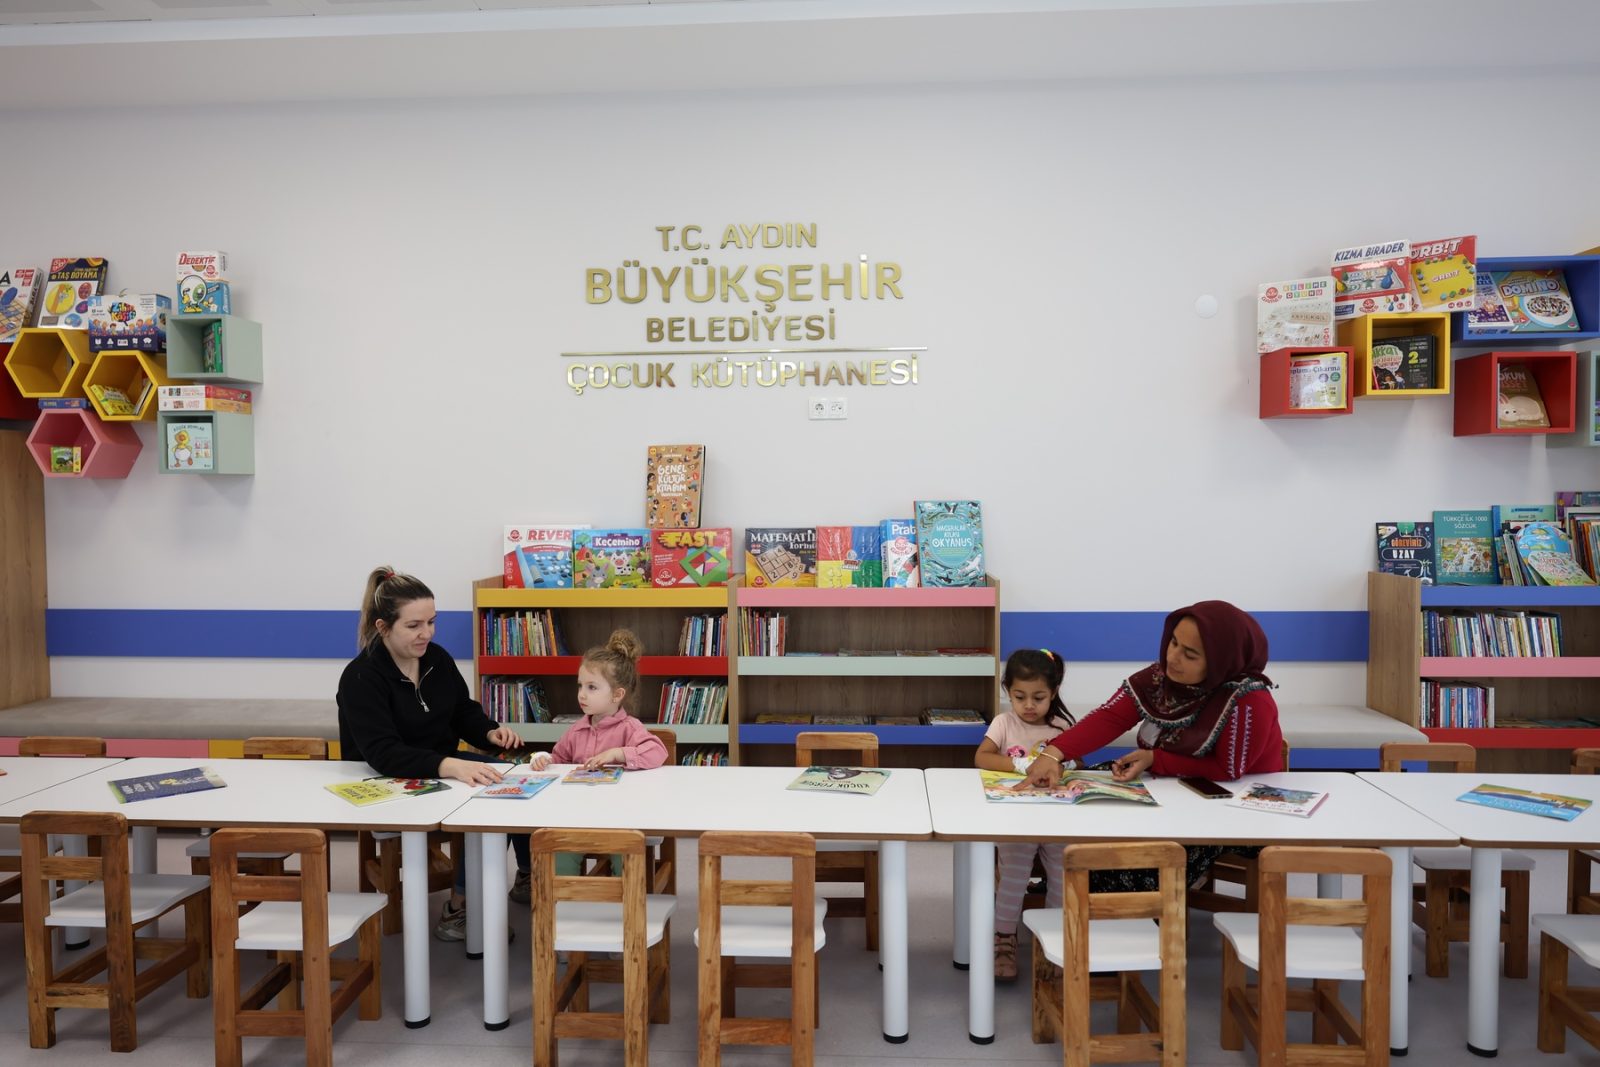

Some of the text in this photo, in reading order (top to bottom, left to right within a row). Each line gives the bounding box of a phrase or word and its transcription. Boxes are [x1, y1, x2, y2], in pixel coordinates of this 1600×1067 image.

[655, 222, 818, 252] T.C. AYDIN
[585, 253, 904, 313] BÜYÜKŞEHİR
[646, 308, 837, 343] BELEDİYESİ
[1408, 350, 1419, 364] 2
[566, 353, 919, 395] ÇOCUK KÜTÜPHANESİ
[657, 530, 717, 548] FAST
[931, 537, 973, 548] OKYANUS
[1392, 549, 1415, 559] UZAY
